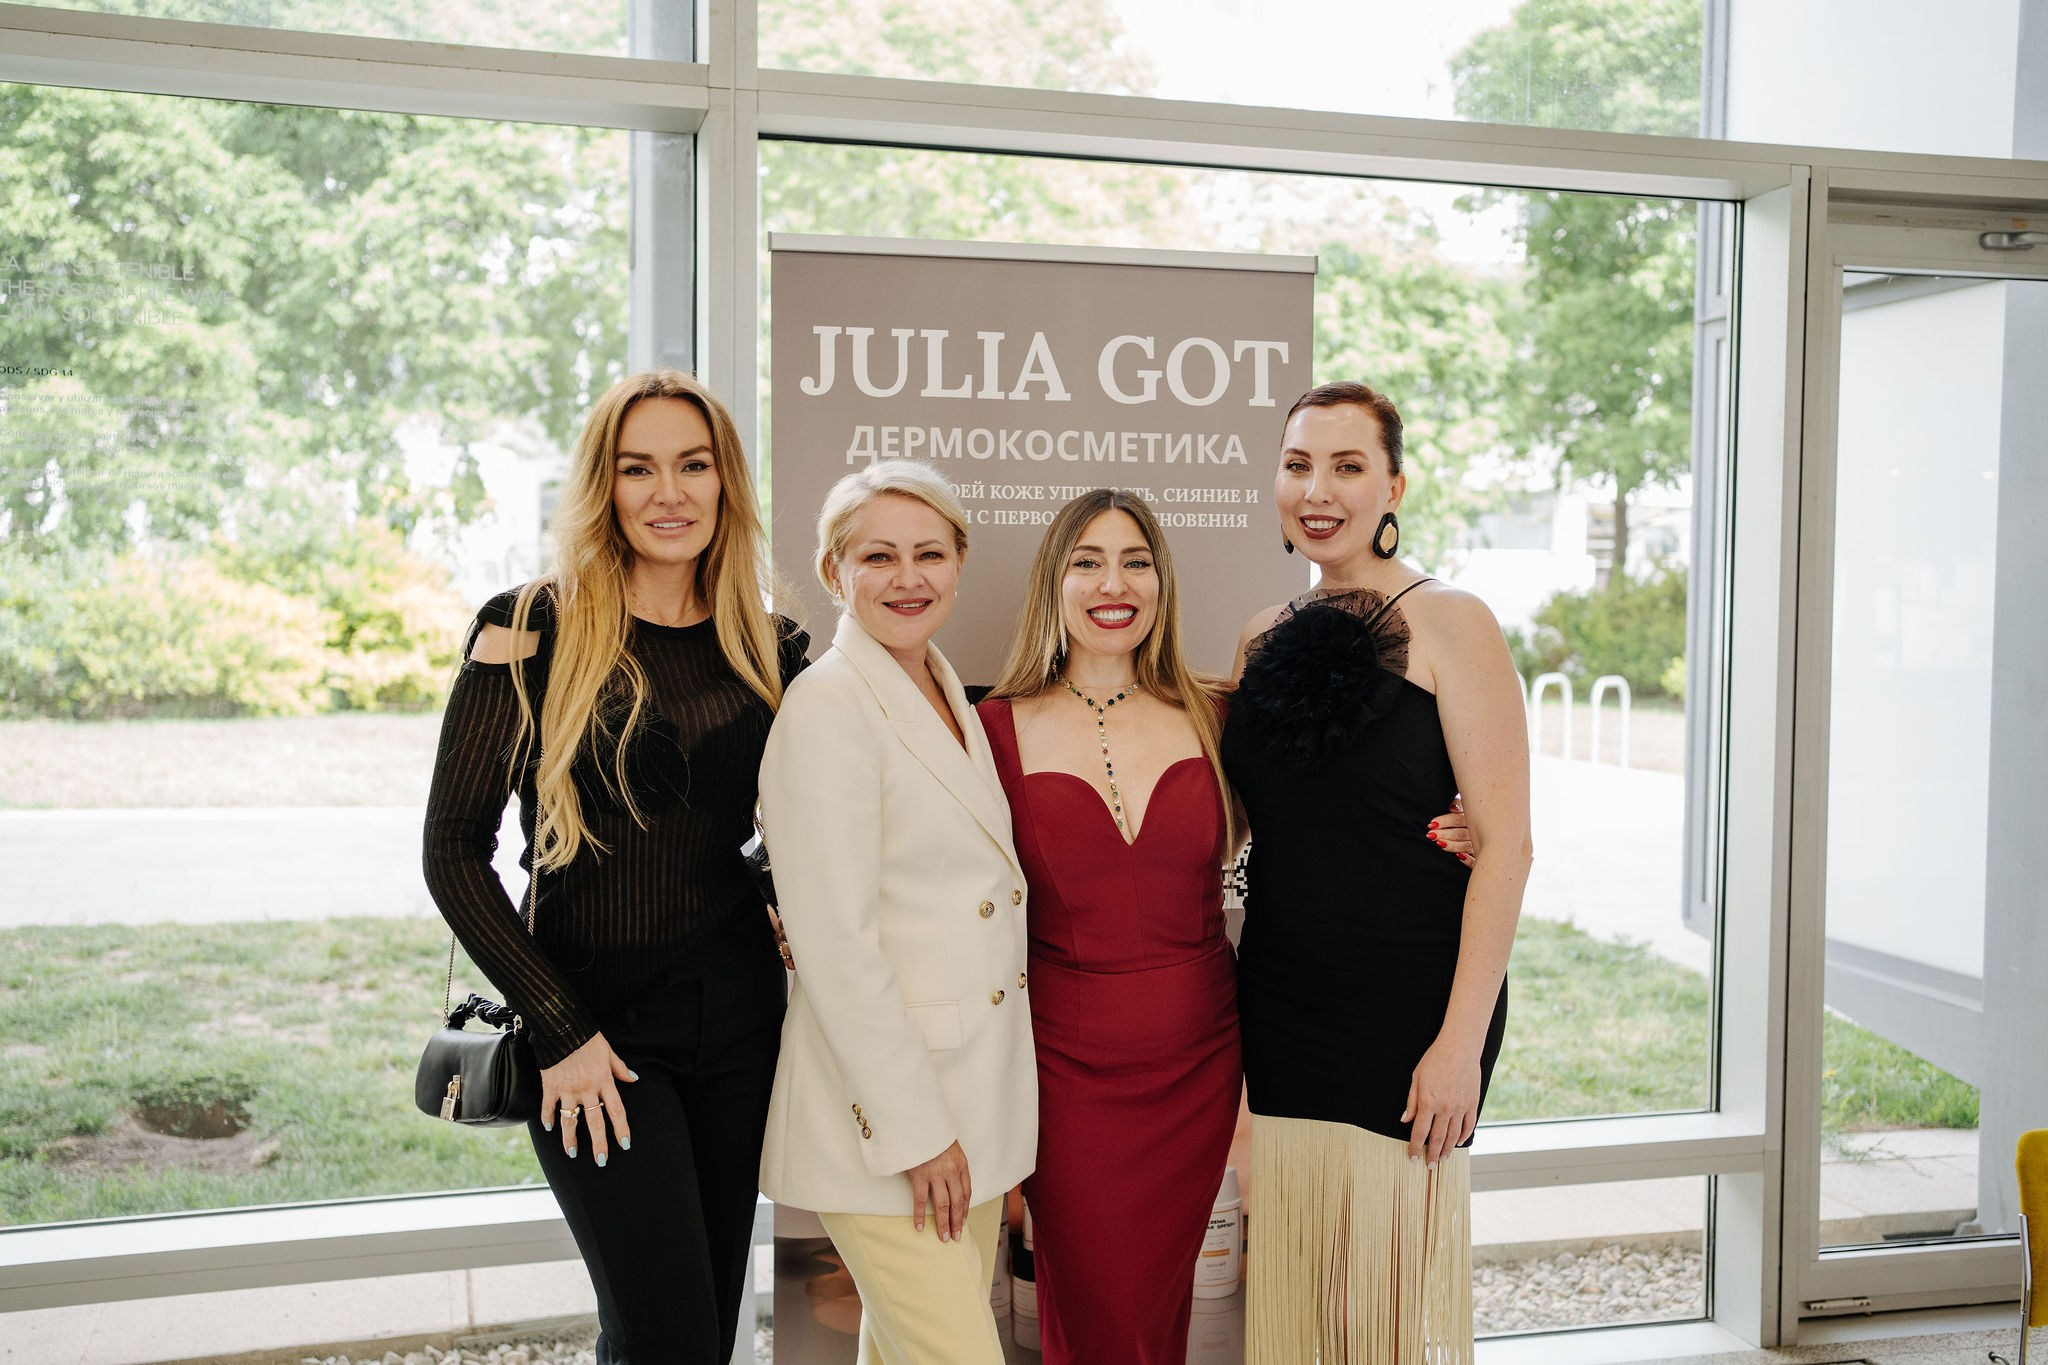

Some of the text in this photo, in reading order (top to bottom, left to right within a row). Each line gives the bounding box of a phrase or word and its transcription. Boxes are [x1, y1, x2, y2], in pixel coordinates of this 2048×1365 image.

[33, 368, 58, 377] SDG
[800, 325, 1290, 408] JULIA GOT
[846, 425, 1248, 466] ДЕРМОКОСМЕТИКА
[990, 484, 1044, 500] КОЖЕ
[1048, 486, 1159, 504] УПРТЬ,
[1163, 488, 1241, 503] СИЯНИЕ
[1245, 489, 1259, 503] И
[976, 509, 989, 524] С
[993, 510, 1060, 526] ПЕРВО
[1153, 512, 1249, 528] НОВЕНИЯ
